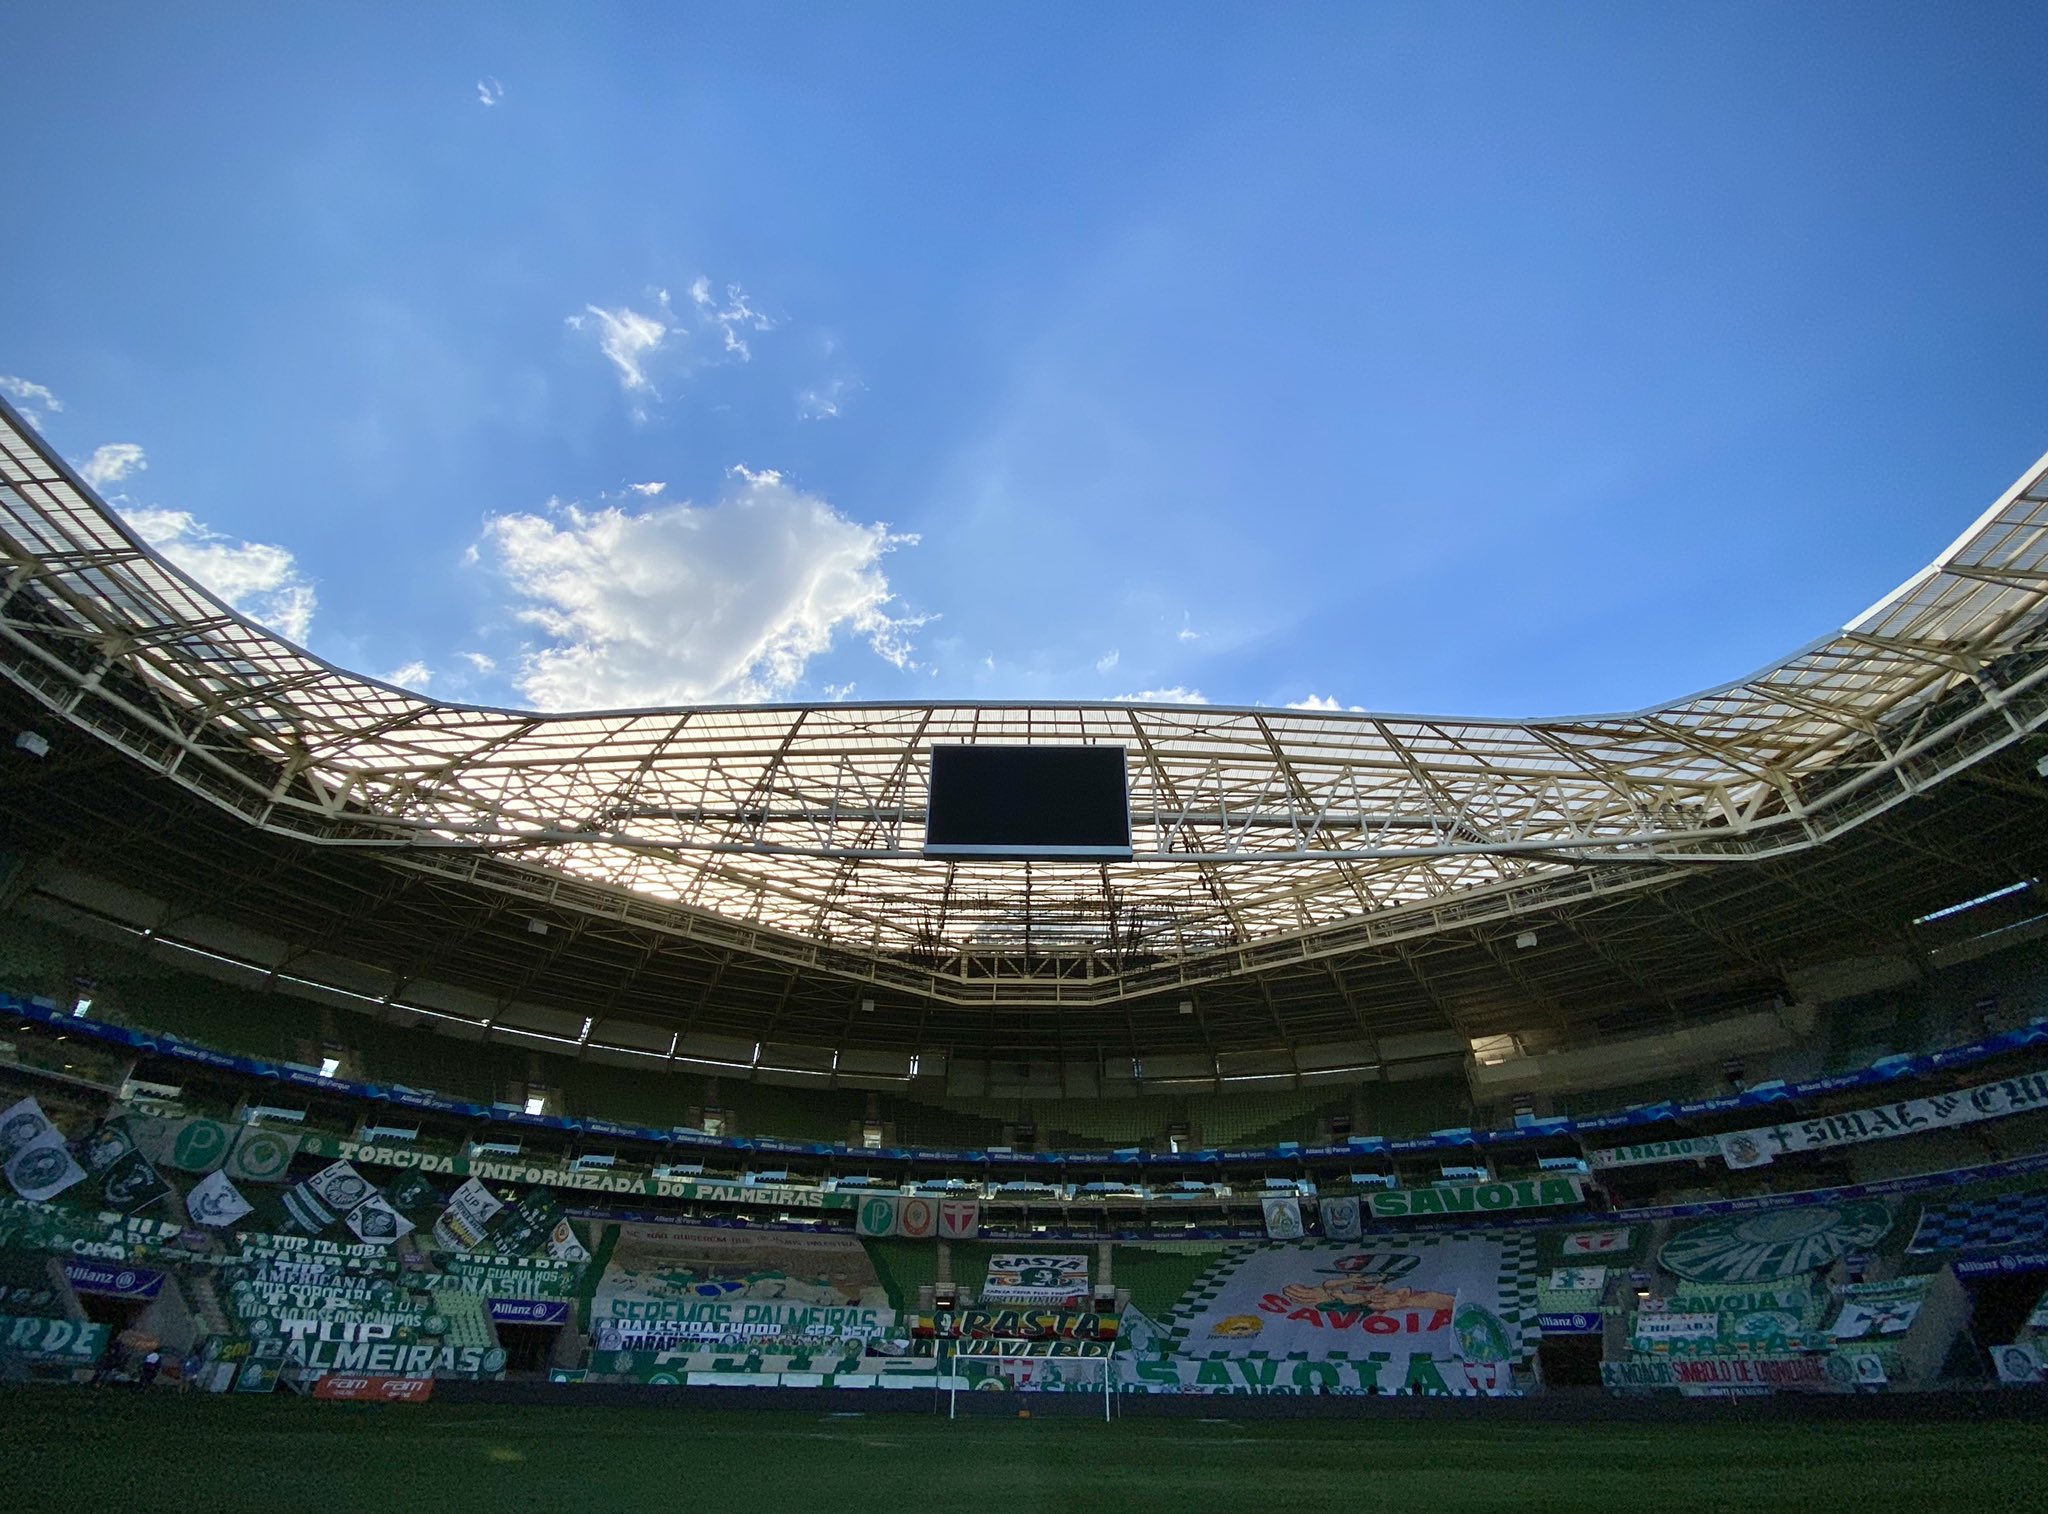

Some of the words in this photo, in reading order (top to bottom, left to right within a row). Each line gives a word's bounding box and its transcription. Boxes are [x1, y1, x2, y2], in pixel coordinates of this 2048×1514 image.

[338, 1141, 454, 1174] TORCIDA
[467, 1160, 647, 1194] UNIFORMIZADA
[657, 1180, 686, 1198] DO
[694, 1185, 824, 1207] PALMEIRAS
[1373, 1177, 1580, 1217] SAVOIA
[462, 1264, 485, 1276] TUP
[487, 1267, 559, 1283] GUARULHOS
[491, 1302, 531, 1318] Allianz
[611, 1300, 732, 1323] SEREMOS
[744, 1304, 877, 1327] PALMEIRAS
[958, 1308, 1101, 1339] RASTA
[1258, 1293, 1454, 1335] SAVOIA
[280, 1319, 393, 1343] TUP
[253, 1338, 484, 1371] PALMEIRAS
[1135, 1351, 1451, 1389] SAVOIA
